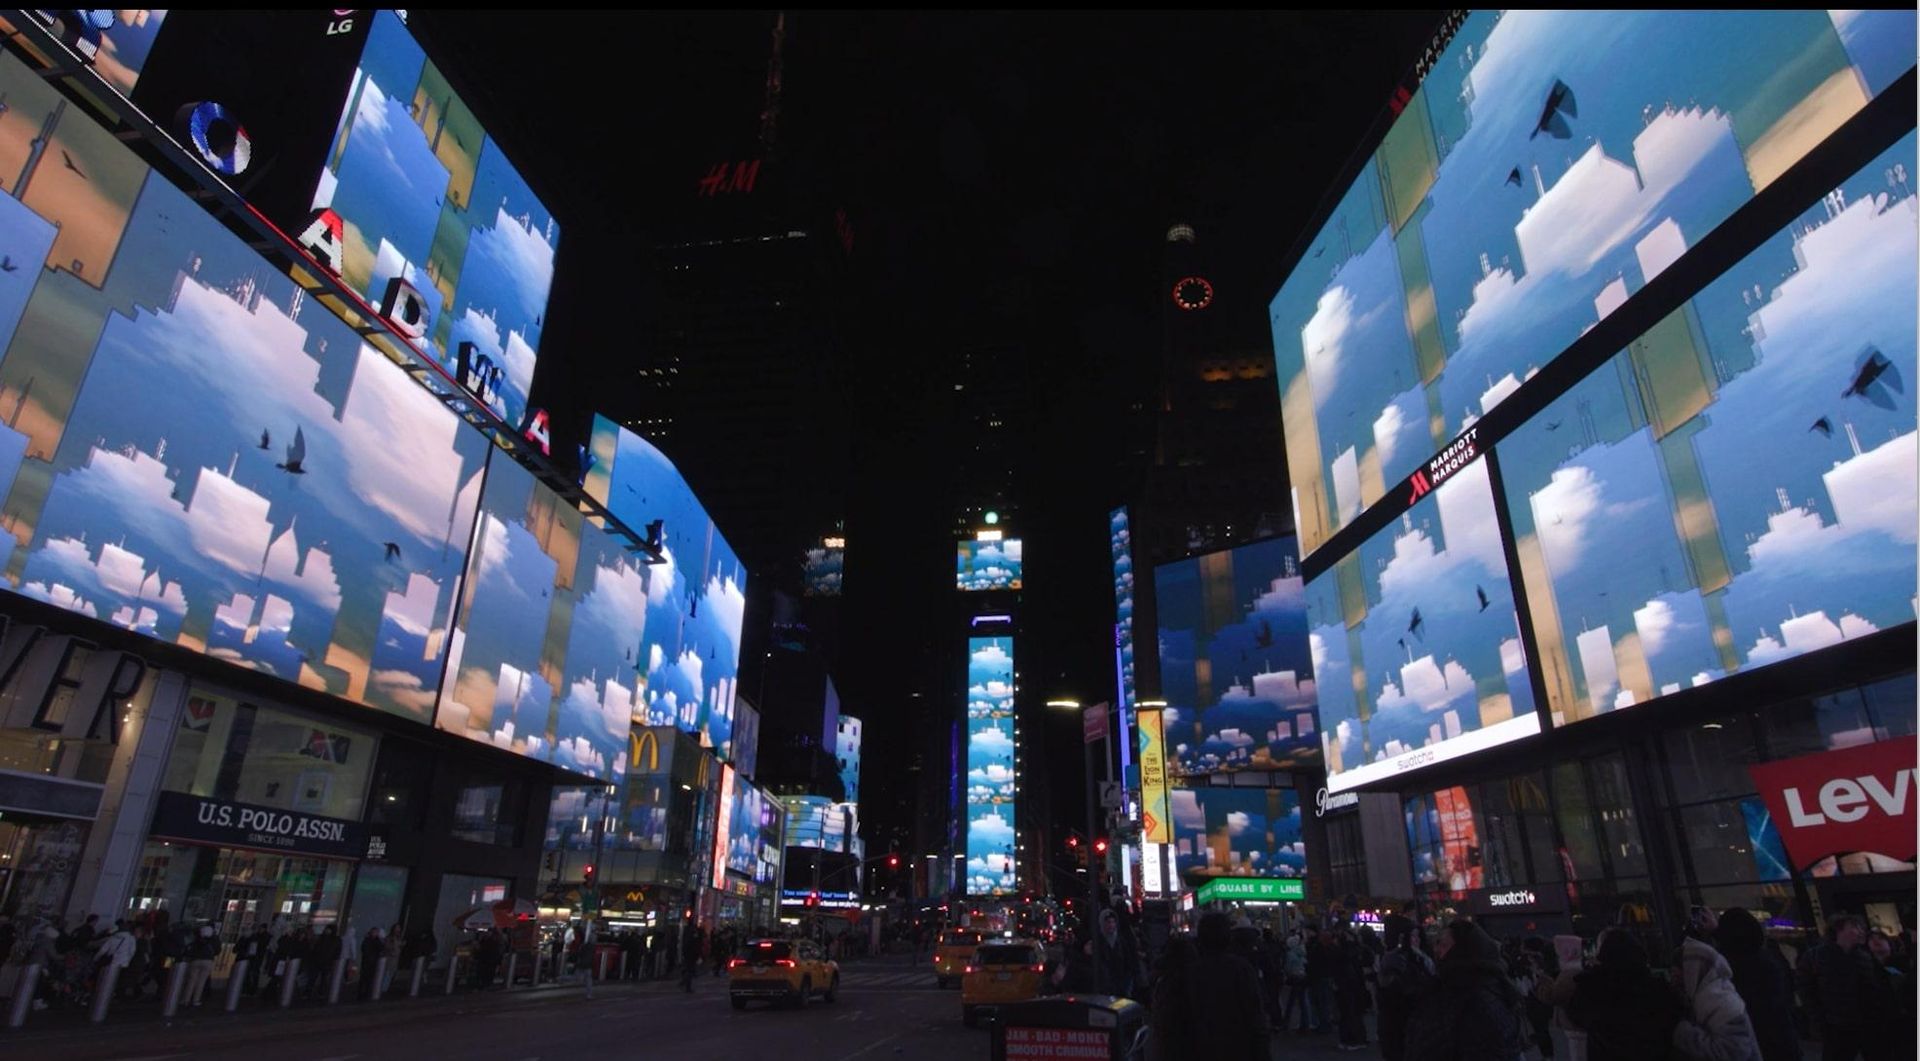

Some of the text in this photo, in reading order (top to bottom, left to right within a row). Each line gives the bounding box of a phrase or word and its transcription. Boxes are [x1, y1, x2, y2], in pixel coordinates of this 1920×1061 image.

[326, 19, 354, 35] LG
[696, 160, 761, 200] H&M
[1430, 428, 1477, 471] MARRIOTT
[1433, 446, 1474, 484] MARQUIS
[198, 802, 345, 842] U.S. POLO ASSN.
[1261, 884, 1274, 894] BY
[1280, 884, 1302, 894] LINE
[1006, 1029, 1110, 1044] JAM BAD MONEY
[1006, 1043, 1111, 1058] SMOOTH CRIMINAL
